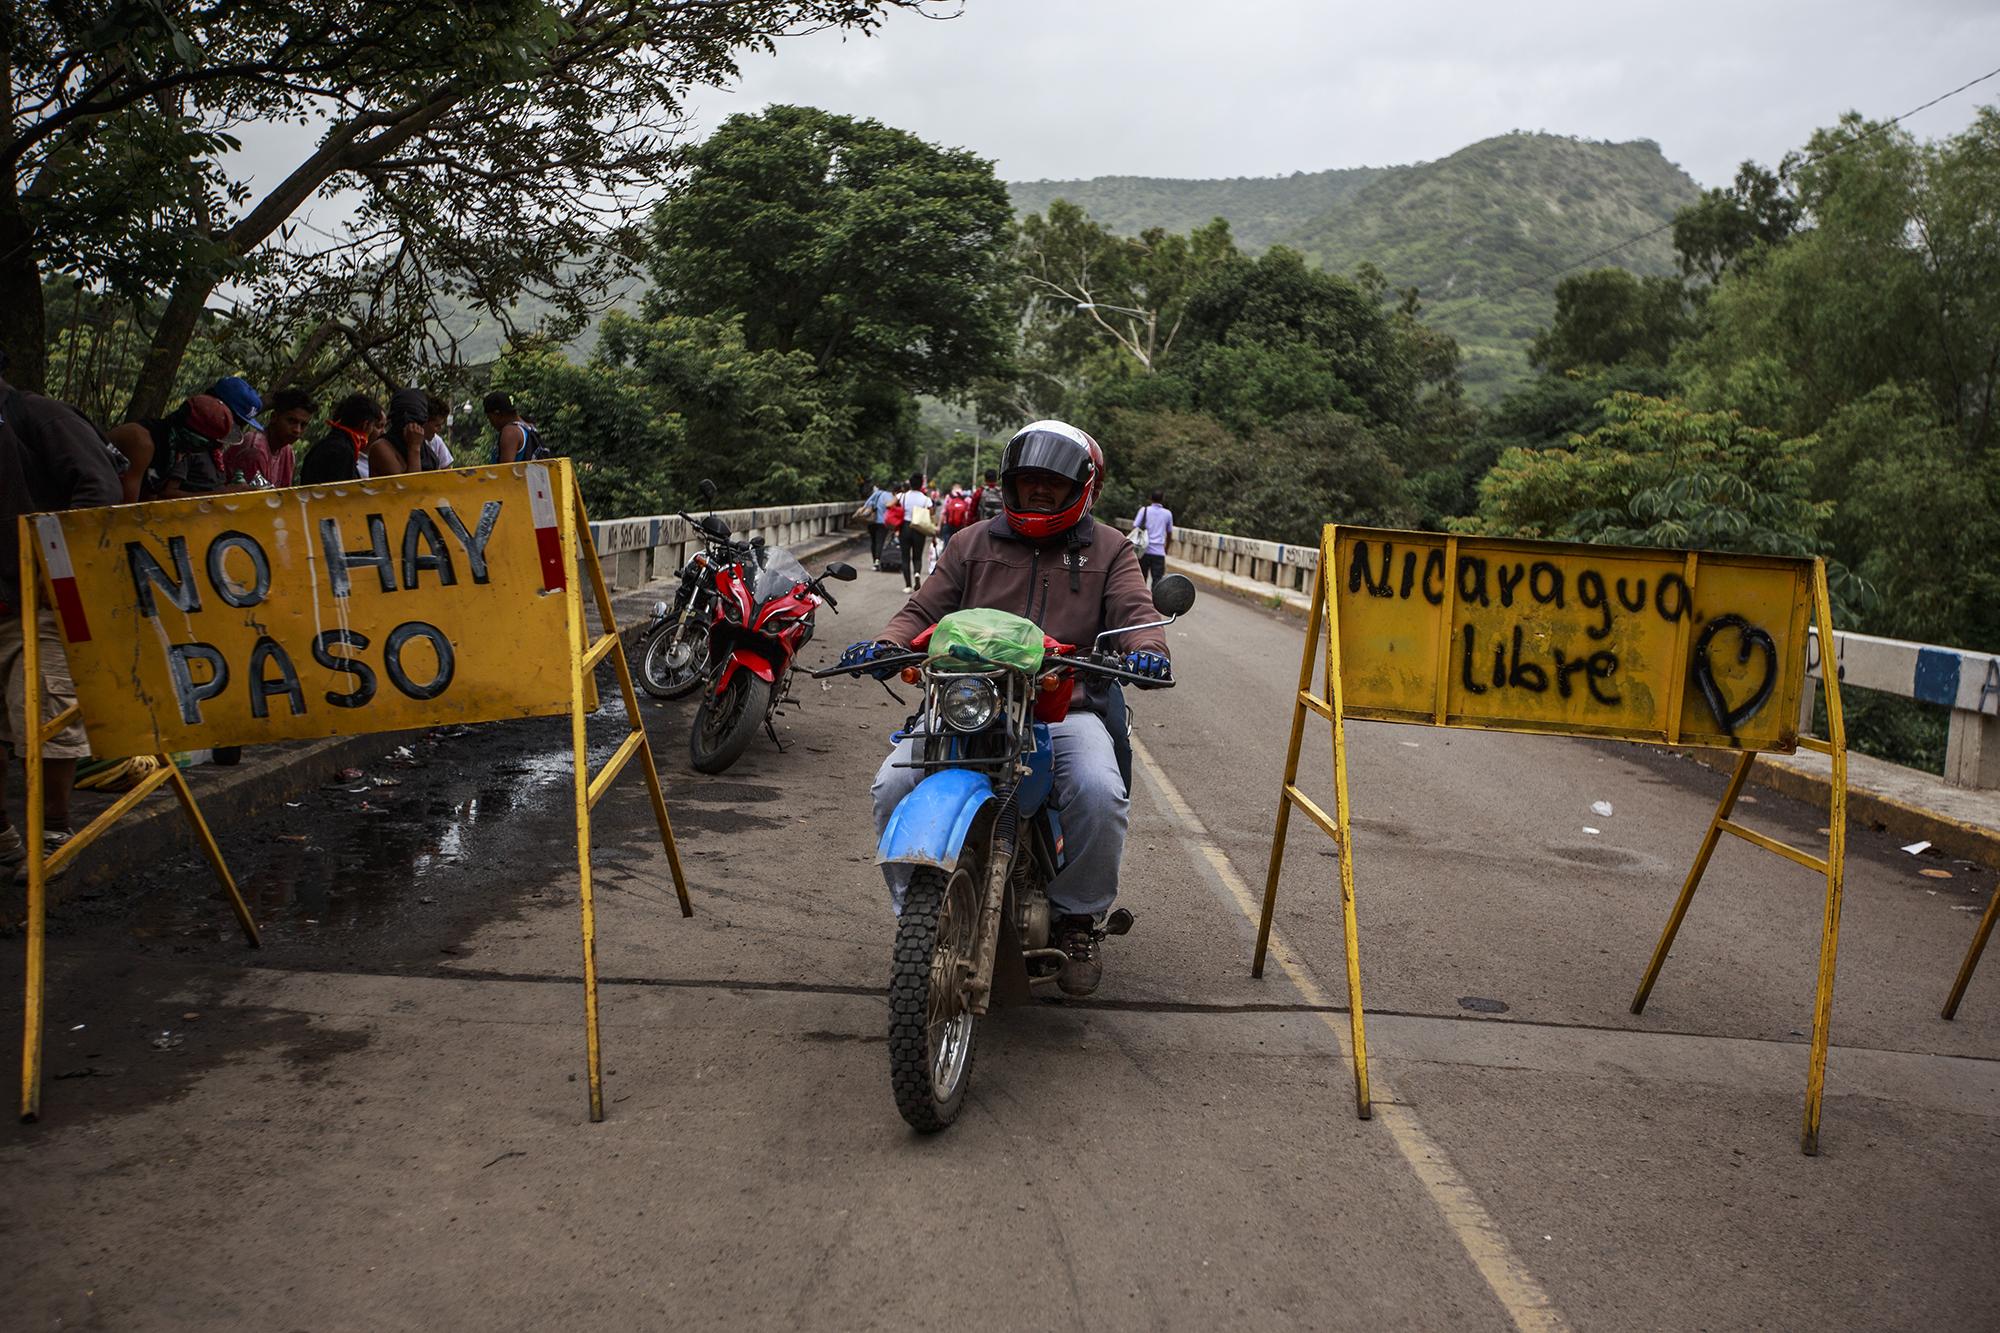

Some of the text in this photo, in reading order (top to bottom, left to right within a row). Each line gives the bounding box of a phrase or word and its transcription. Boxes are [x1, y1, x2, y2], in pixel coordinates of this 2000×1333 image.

[126, 501, 502, 618] NO HAY
[1348, 541, 1693, 639] Nicaragua
[169, 621, 455, 725] PASO
[1463, 624, 1621, 705] Libre
